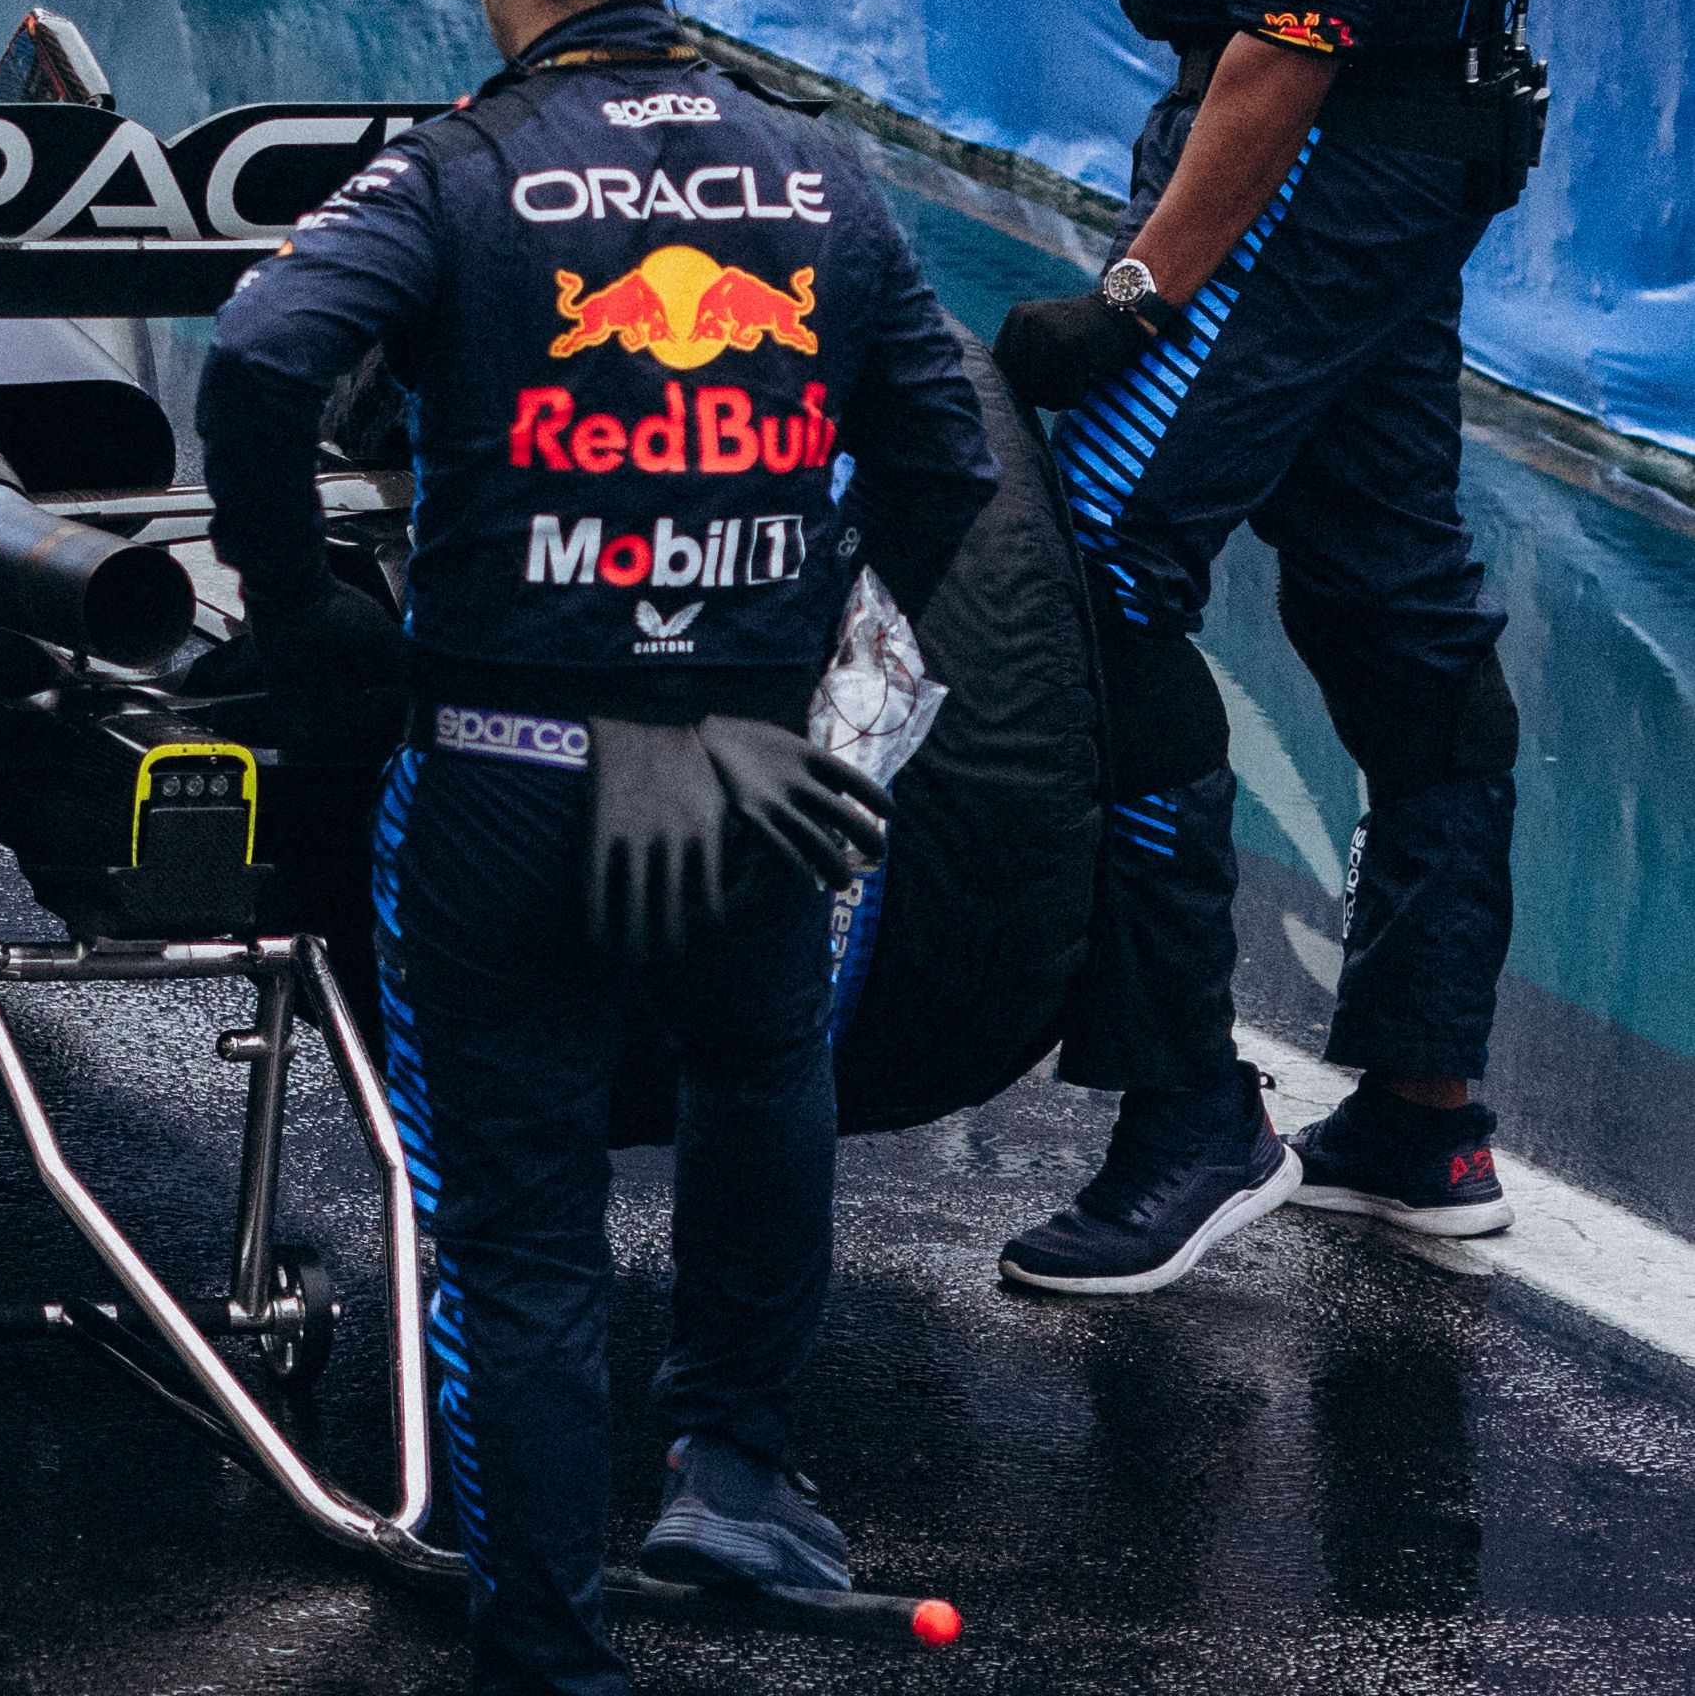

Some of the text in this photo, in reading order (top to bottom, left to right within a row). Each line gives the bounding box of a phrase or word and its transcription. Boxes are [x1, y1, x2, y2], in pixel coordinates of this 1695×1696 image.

[603, 93, 719, 127] sparco
[512, 165, 832, 224] ORACLE
[511, 380, 687, 472] Red
[525, 513, 741, 588] Mobil
[437, 708, 589, 762] sparco
